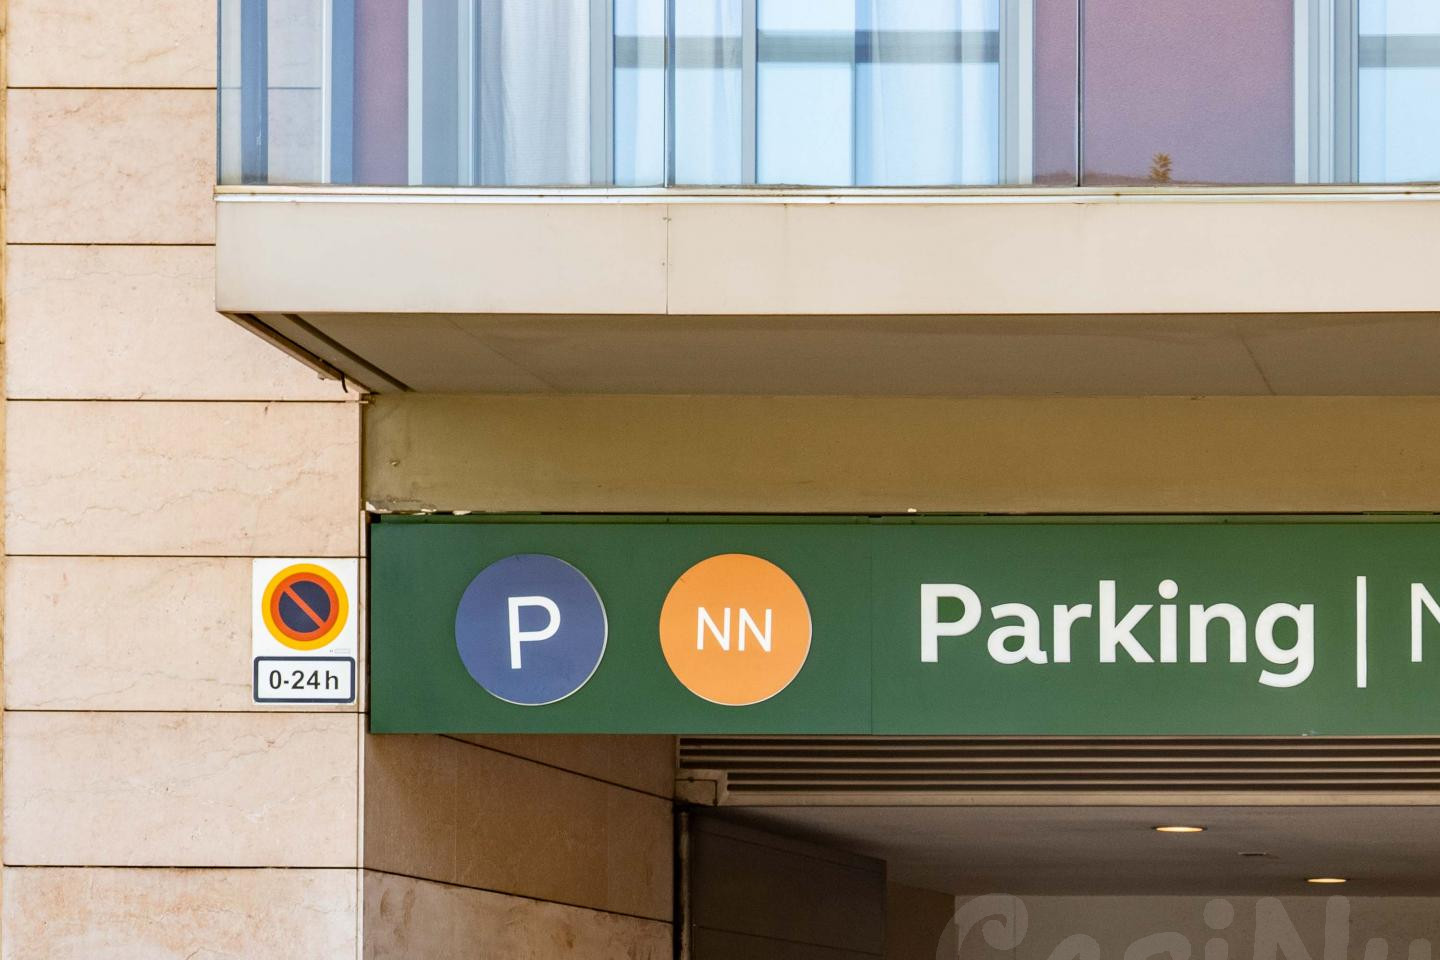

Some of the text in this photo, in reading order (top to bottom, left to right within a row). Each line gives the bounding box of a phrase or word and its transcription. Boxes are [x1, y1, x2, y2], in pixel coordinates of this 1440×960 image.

[507, 595, 561, 670] P
[696, 606, 773, 653] NN
[920, 578, 1316, 689] Parking
